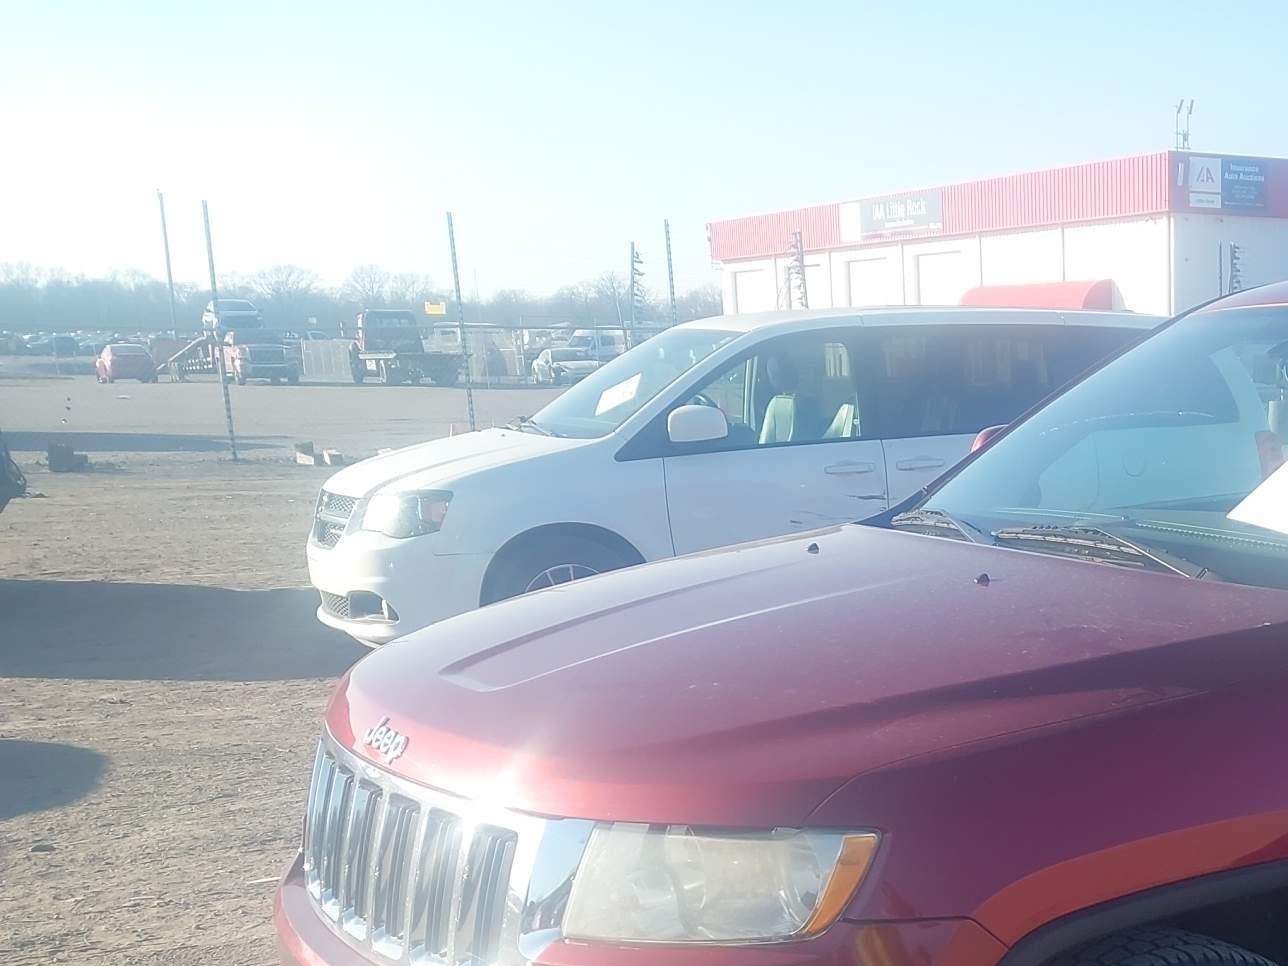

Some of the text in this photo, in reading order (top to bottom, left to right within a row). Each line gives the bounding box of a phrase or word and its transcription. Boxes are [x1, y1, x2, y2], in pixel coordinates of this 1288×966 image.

[886, 199, 905, 219] Little
[907, 198, 927, 217] Rock
[363, 716, 411, 766] Jeep
